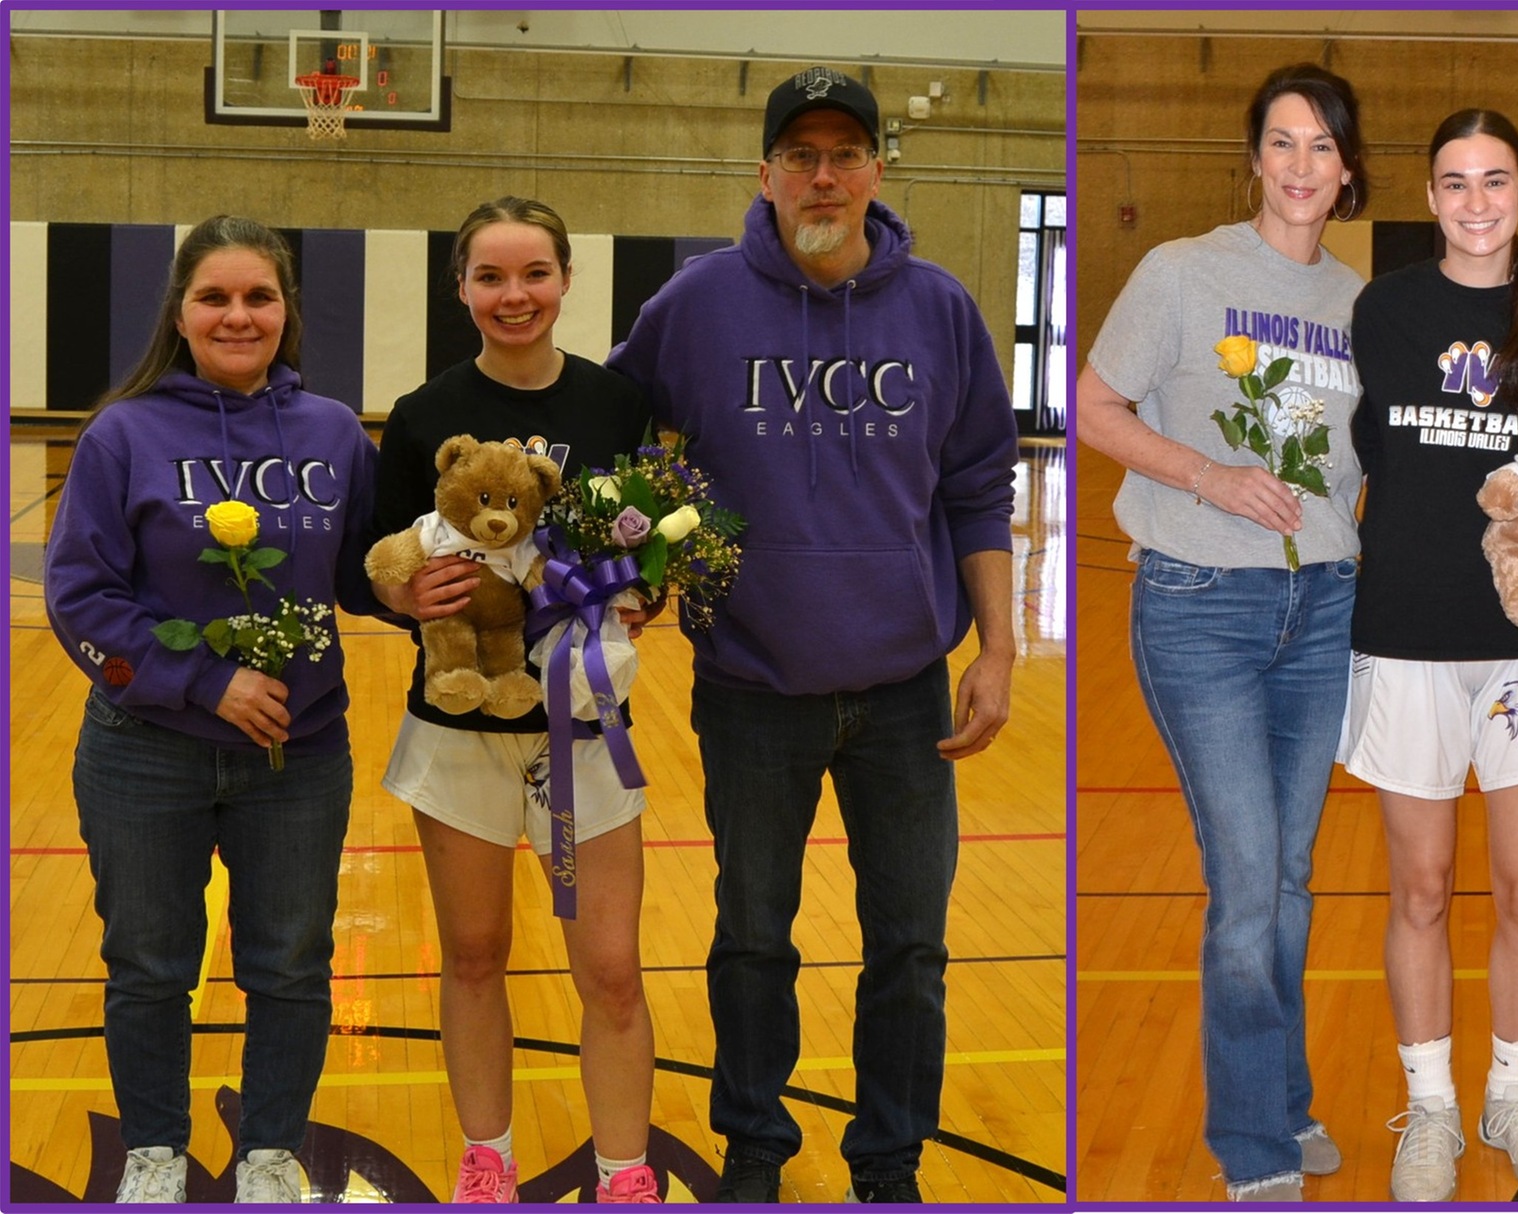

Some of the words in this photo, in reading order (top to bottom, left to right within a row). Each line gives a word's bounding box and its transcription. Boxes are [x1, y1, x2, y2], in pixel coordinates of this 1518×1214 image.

[1225, 307, 1299, 350] ILLINOIS
[1303, 320, 1353, 362] VALLE
[739, 356, 916, 417] IVCC
[756, 421, 899, 438] EAGLES
[1388, 405, 1518, 435] BASKETBA
[1419, 428, 1466, 447] ILLINOIS
[1468, 433, 1511, 451] VALLEY
[169, 455, 341, 511] IVCC
[193, 515, 332, 530] ELES
[80, 641, 106, 666] 2
[552, 809, 576, 888] Sarah
